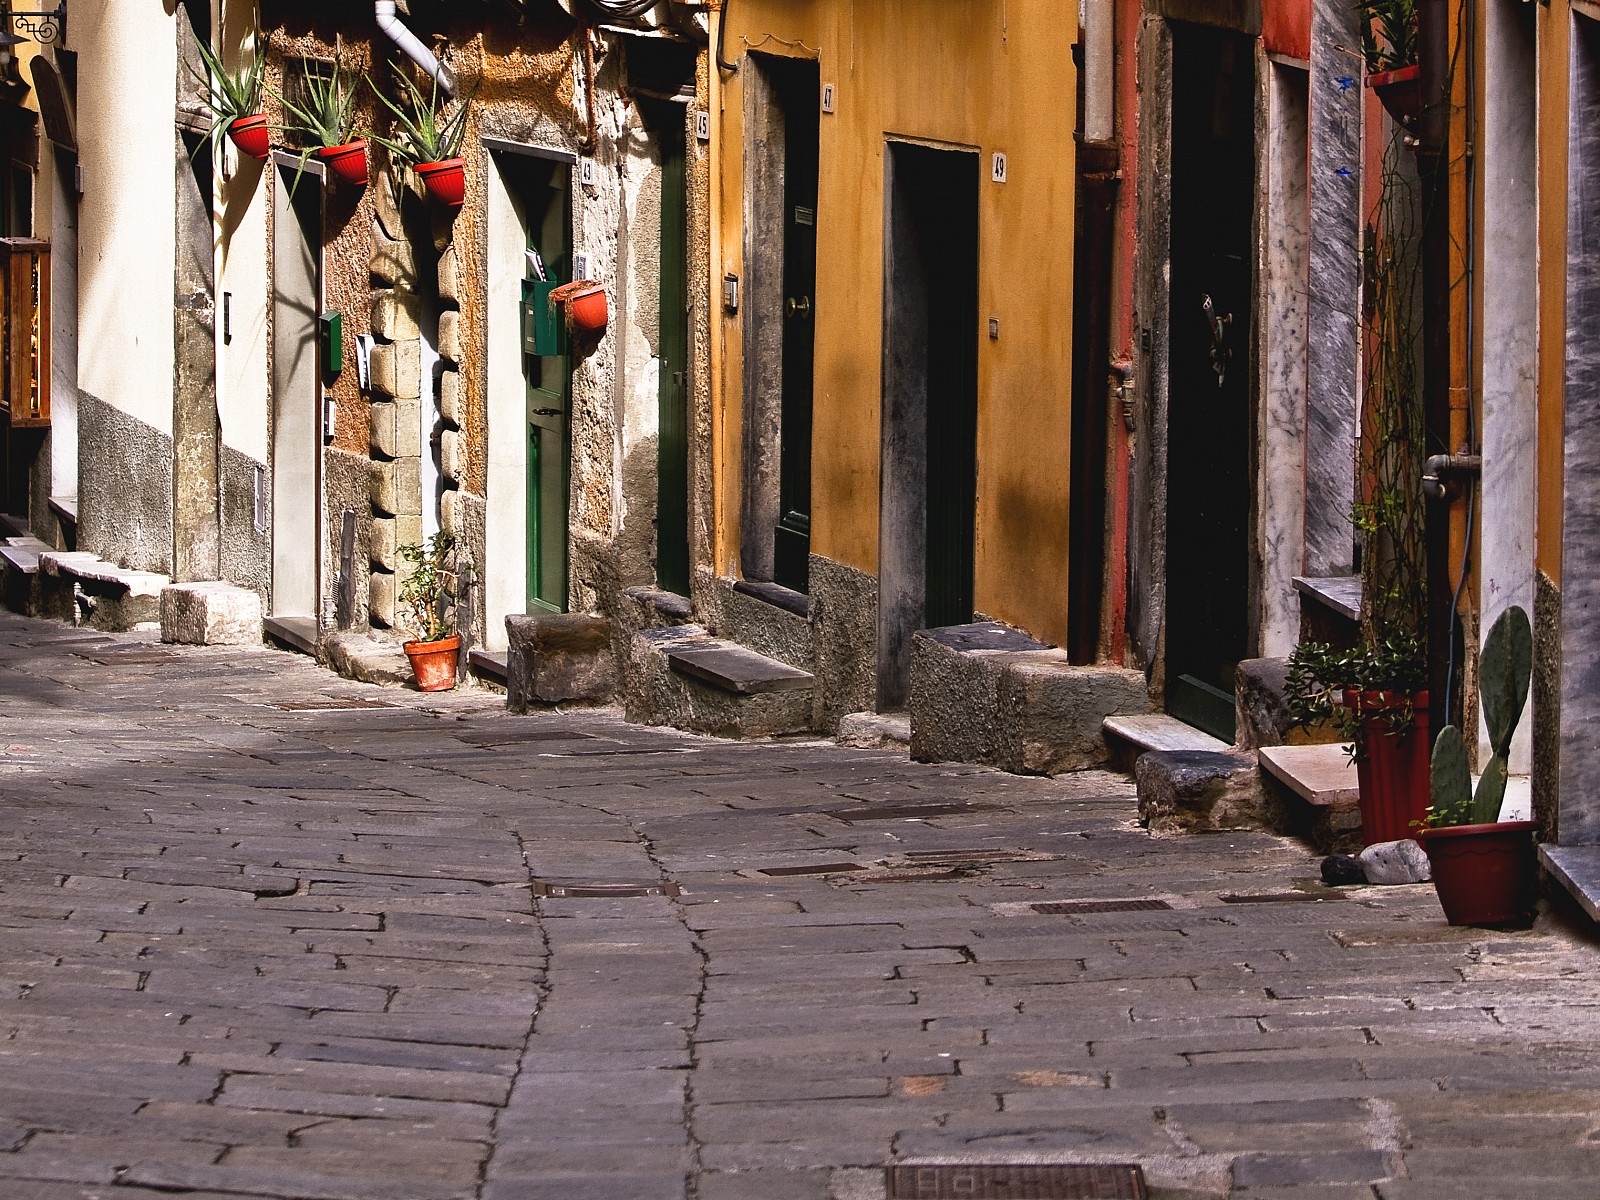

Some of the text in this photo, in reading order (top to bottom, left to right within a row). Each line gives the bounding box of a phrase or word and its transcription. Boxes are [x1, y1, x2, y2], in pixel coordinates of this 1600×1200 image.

[824, 87, 832, 108] 47
[698, 115, 707, 135] 45
[994, 156, 1004, 178] 49
